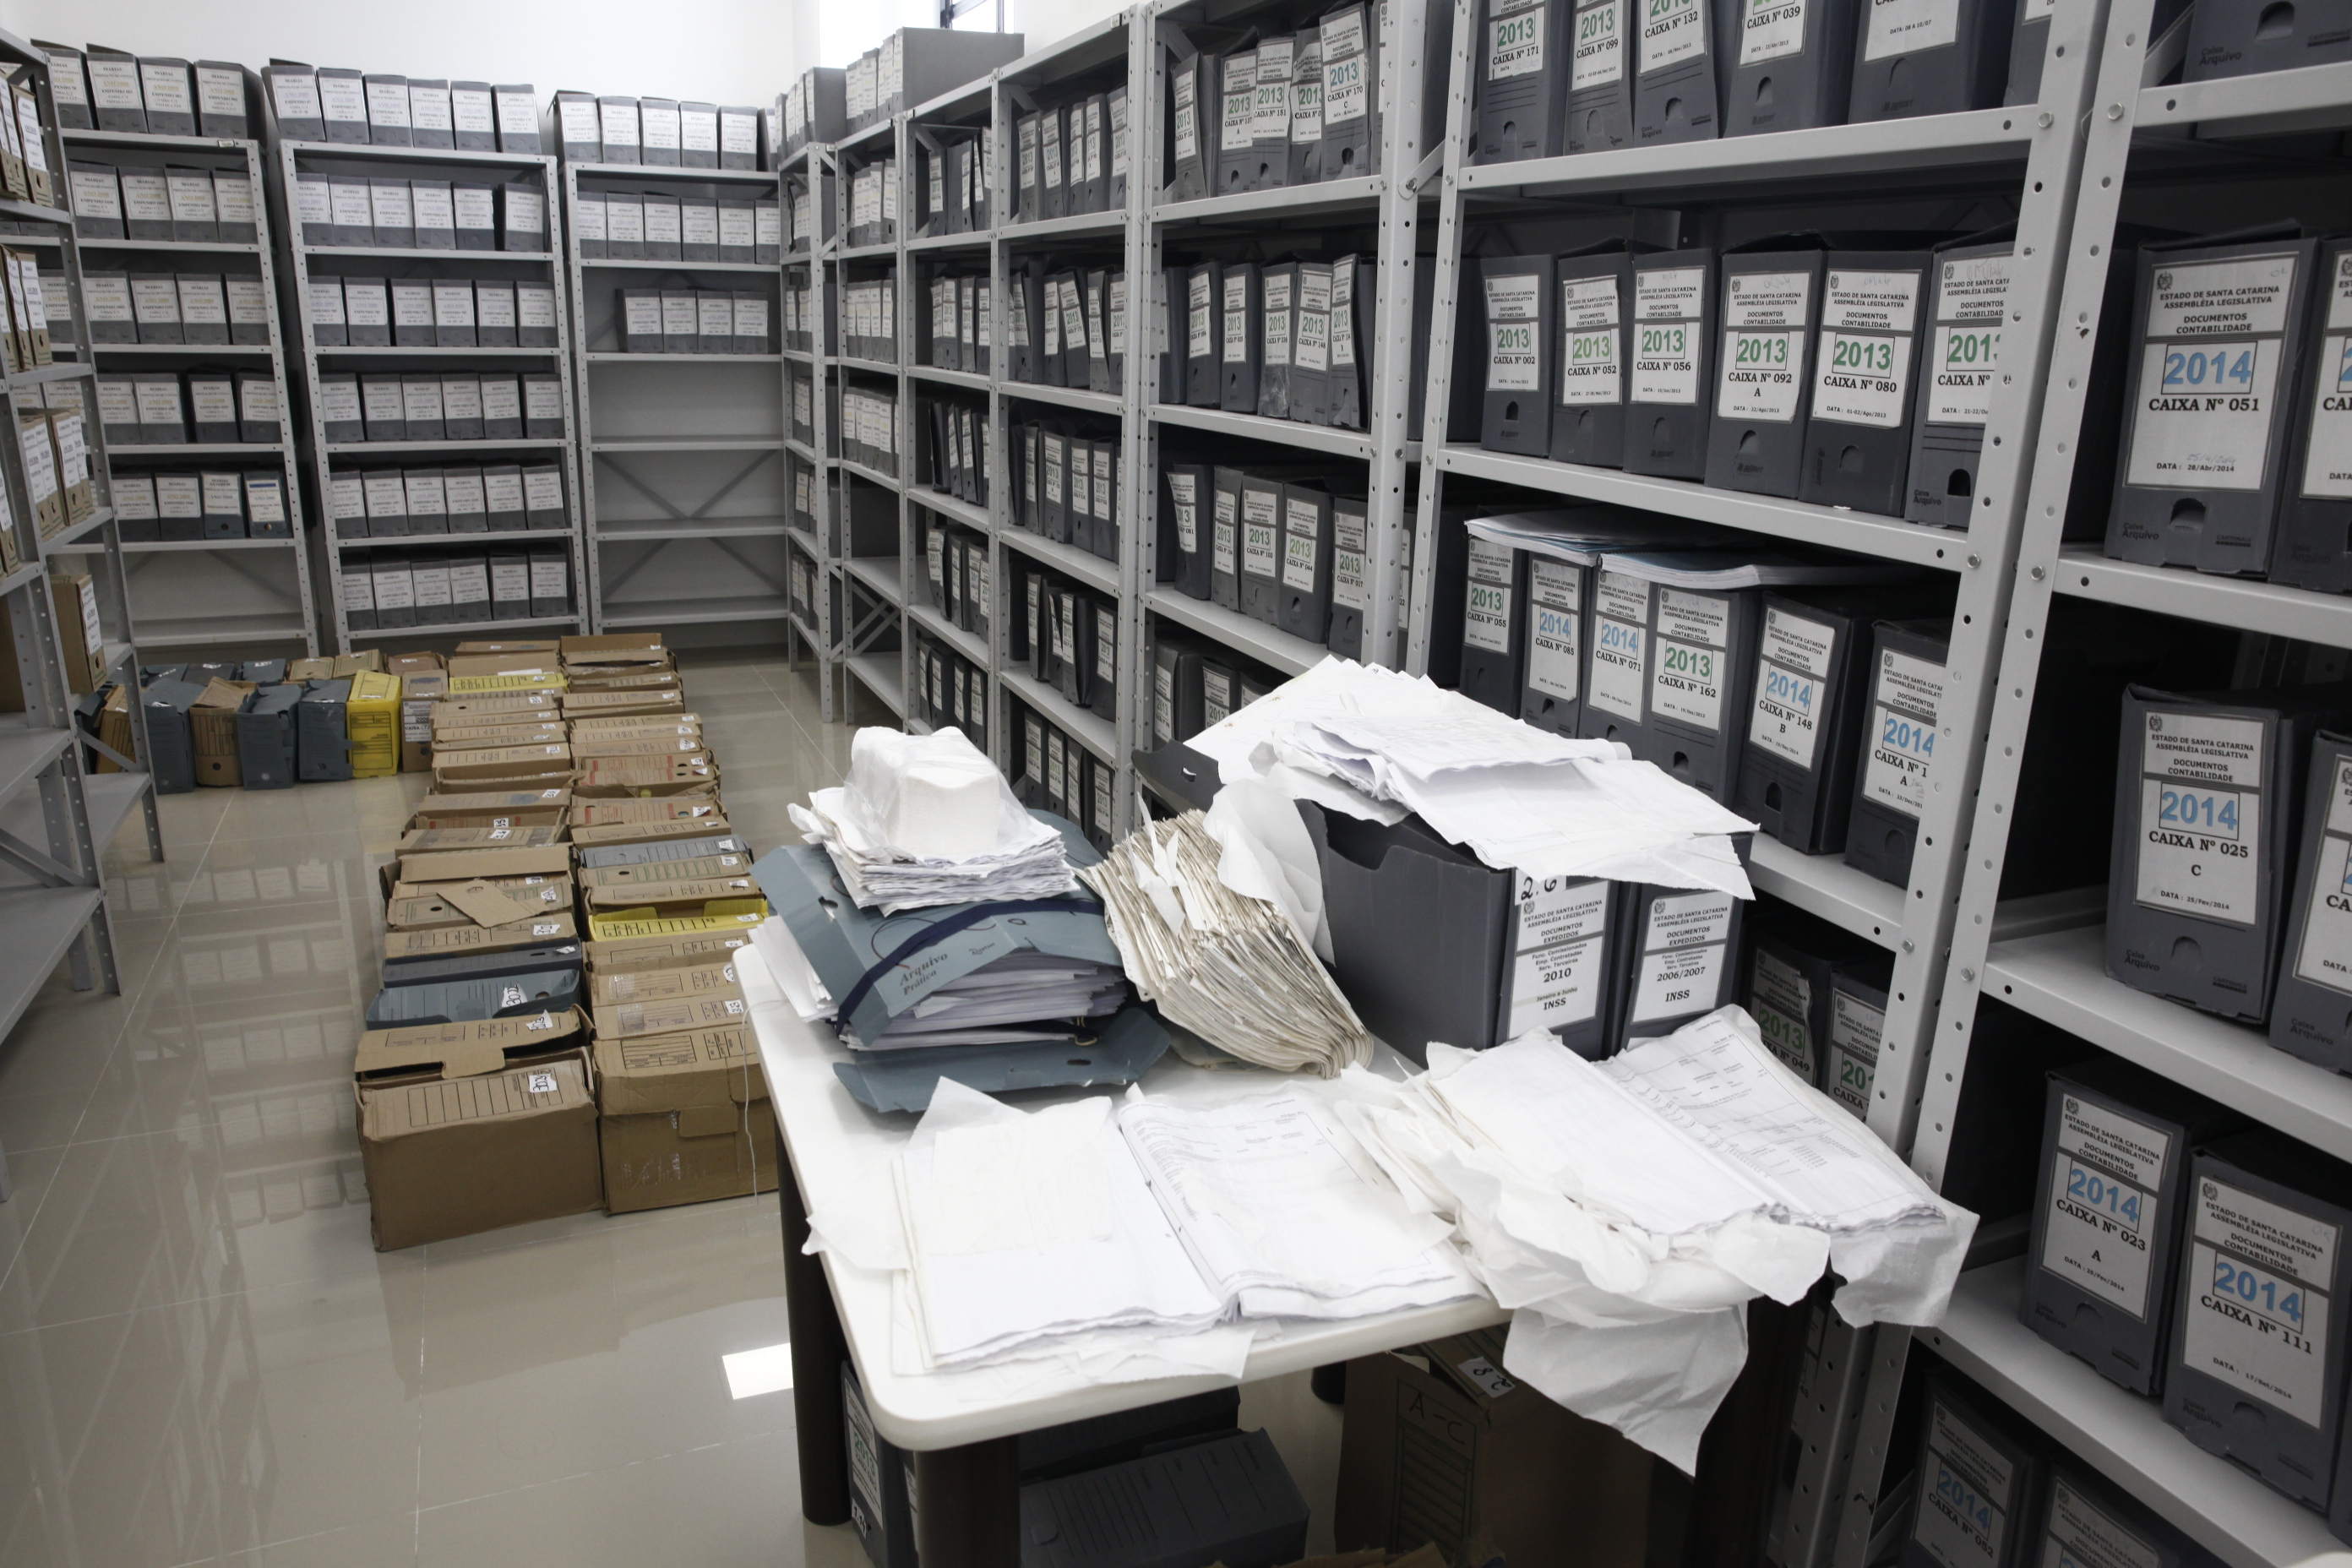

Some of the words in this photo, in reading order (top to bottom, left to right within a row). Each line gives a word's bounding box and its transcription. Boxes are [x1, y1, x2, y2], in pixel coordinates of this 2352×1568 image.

[1582, 8, 1614, 40] 2013
[1645, 22, 1670, 38] CAIXA
[1684, 11, 1697, 24] 132
[1747, 14, 1770, 29] CAIXA
[1783, 7, 1800, 19] 039
[1498, 18, 1534, 46] 2013
[1492, 52, 1514, 65] CAIXA
[1527, 46, 1538, 56] 171
[1576, 46, 1595, 58] CAIXA
[1605, 38, 1618, 50] 099
[1228, 95, 1250, 114] 2013
[1258, 86, 1284, 105] 2013
[2159, 291, 2191, 300] ESTADO
[2206, 289, 2233, 297] SANTA
[2235, 286, 2279, 295] CATARINA
[2164, 298, 2214, 308] ASSEMBLÉIA
[2217, 296, 2272, 306] LEGISLATIVA
[1961, 301, 2004, 309] DOCUMENTOS
[1846, 311, 1887, 319] DOCUMENTOS
[2183, 313, 2246, 324] DOCUMENTOS
[1303, 316, 1324, 335] 2013
[2176, 323, 2251, 334] CONTABILIDADE
[1498, 329, 1529, 348] 2013
[1573, 336, 1610, 358] 2013
[1643, 330, 1684, 352] 2013
[1493, 356, 1512, 364] CAIXA
[1522, 356, 1535, 364] 002
[1737, 340, 1786, 363] 2013
[1833, 340, 1891, 370] 2013
[1567, 367, 1590, 376] CAIXA
[1602, 365, 1616, 374] 052
[1636, 362, 1660, 370] CAIXA
[1673, 362, 1690, 371] 056
[2164, 351, 2251, 384] 2014
[1729, 372, 1756, 382] CAIXA
[1773, 373, 1792, 383] 092
[1824, 375, 1856, 389] CAIXA
[1876, 381, 1897, 392] 080
[1938, 375, 1974, 385] CAIXA
[1754, 388, 1761, 397] A
[2148, 398, 2199, 411] CAIXA
[2229, 398, 2258, 411] 051
[1249, 529, 1271, 546] 2013
[1290, 539, 1310, 558] 2013
[1472, 588, 1502, 611] 2013
[1467, 612, 1484, 622] CAIXA
[1494, 618, 1510, 627] 055
[1540, 612, 1570, 638] 2014
[1535, 637, 1554, 650] CAIXA
[1563, 645, 1574, 656] 085
[1602, 624, 1637, 653] 2014
[1596, 650, 1617, 664] CAIXA
[1628, 660, 1641, 672] 071
[1665, 647, 1711, 678] 2013
[1658, 675, 1685, 689] CAIXA
[1700, 686, 1716, 698] 162
[1767, 672, 1810, 708] 2014
[1759, 700, 1783, 718] CAIXA
[1797, 716, 1812, 730] 148
[1780, 725, 1786, 733] B
[1884, 719, 1935, 758] 2014
[2151, 733, 2178, 743] ESTADO
[2216, 741, 2253, 751] CATARINA
[2155, 743, 2198, 753] ASSEMBLÉIA
[2201, 748, 2248, 759] LEGISLATIVA
[1875, 749, 1904, 769] CAIXA
[2173, 758, 2228, 771] DOCUMENTOS
[2168, 767, 2233, 781] CONTABILIDADE
[2160, 792, 2238, 830] 2014
[2148, 830, 2194, 848] CAIXA
[2220, 842, 2248, 858] 025
[2191, 864, 2202, 876] C
[1524, 912, 1545, 922] ESTADO
[1555, 906, 1573, 914] SANTA
[1575, 899, 1602, 910] CATARINA
[1527, 916, 1561, 928] ASSEMBLÉIA
[1562, 906, 1598, 919] LEGISLATIVA
[1541, 922, 1582, 936] DOCUMENTOS
[1544, 930, 1578, 944] EXPEDIDOS
[1666, 926, 1710, 938] DOCUMENTOS
[1669, 934, 1705, 945] EXPEDIDOS
[900, 953, 948, 986] Arquivo
[1544, 967, 1571, 983] 2010
[1657, 966, 1706, 981] 2006/2007
[903, 970, 936, 995] Prático
[1544, 997, 1565, 1010] INSS
[1665, 989, 1690, 1001] INSS
[1760, 1010, 1805, 1050] 2013
[1792, 1057, 1810, 1072] 049
[1834, 1088, 1864, 1110] CAIXA
[2069, 1168, 2138, 1223] 2014
[2056, 1199, 2098, 1227] CAIXA
[2121, 1230, 2145, 1250] 023
[2092, 1250, 2102, 1262] A
[2224, 1240, 2298, 1275] CONTABILIDADE
[2230, 1233, 2293, 1264] DOCUMENTOS
[2214, 1262, 2301, 1323] 2014
[2201, 1295, 2252, 1326] CAIXA
[2283, 1331, 2311, 1354] 111
[1937, 1470, 1990, 1530] 2014
[1929, 1493, 1959, 1527] CAIXA
[1975, 1534, 1994, 1559] 052
